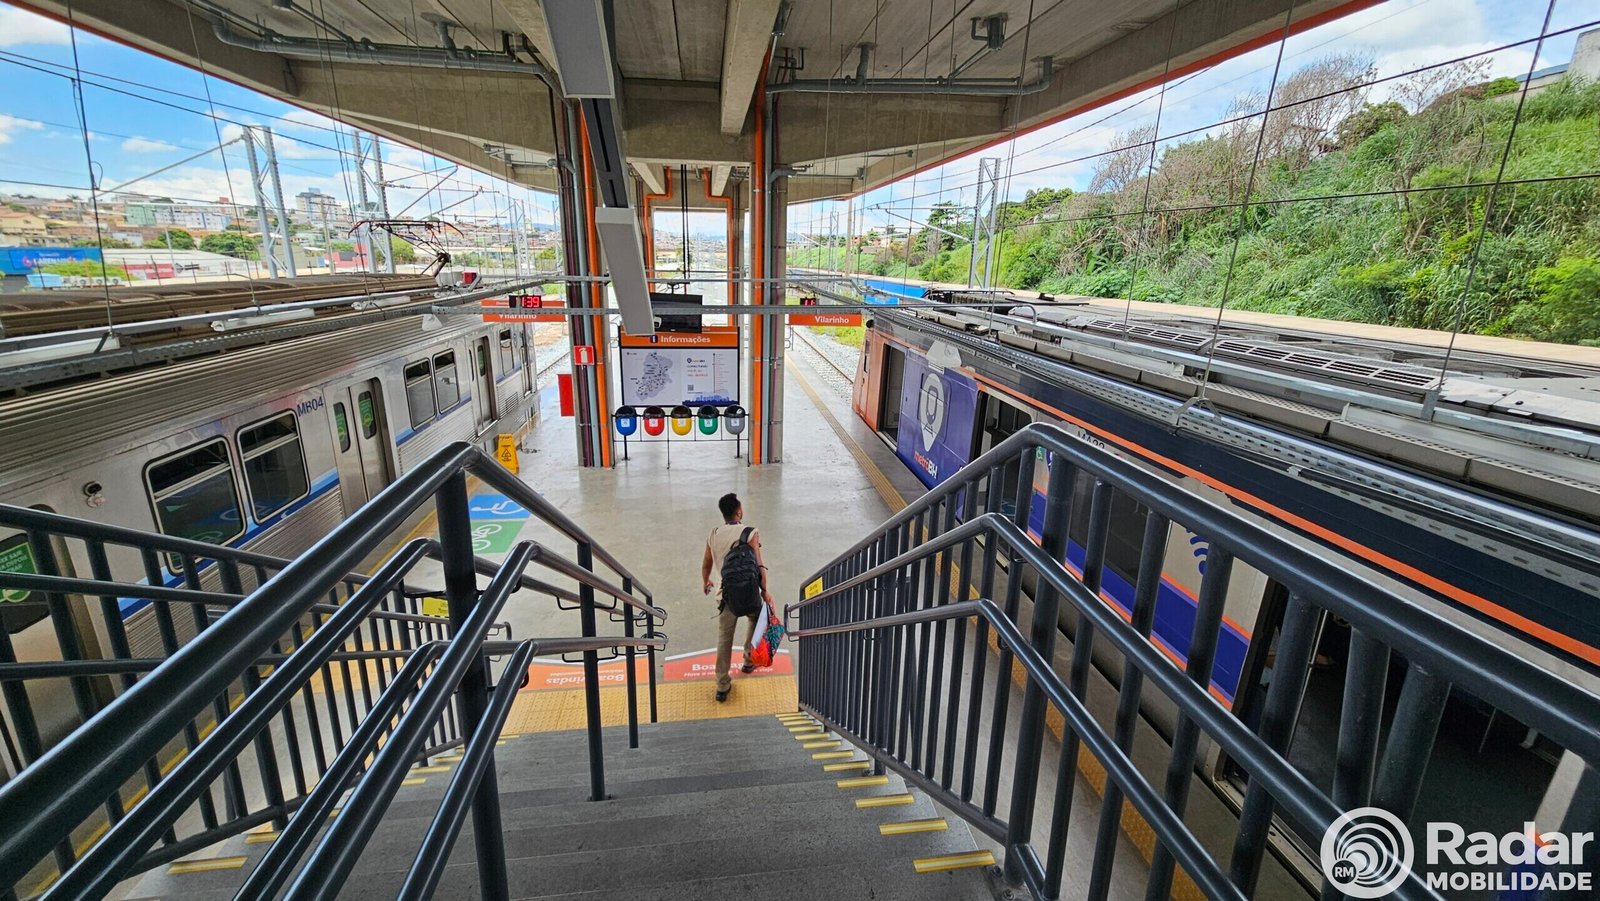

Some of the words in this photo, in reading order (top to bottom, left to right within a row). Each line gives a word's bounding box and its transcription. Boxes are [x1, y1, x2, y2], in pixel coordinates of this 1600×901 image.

[814, 316, 850, 324] Vilarinho
[660, 335, 711, 344] Informações
[296, 396, 324, 417] MB04
[913, 450, 938, 479] metroBH
